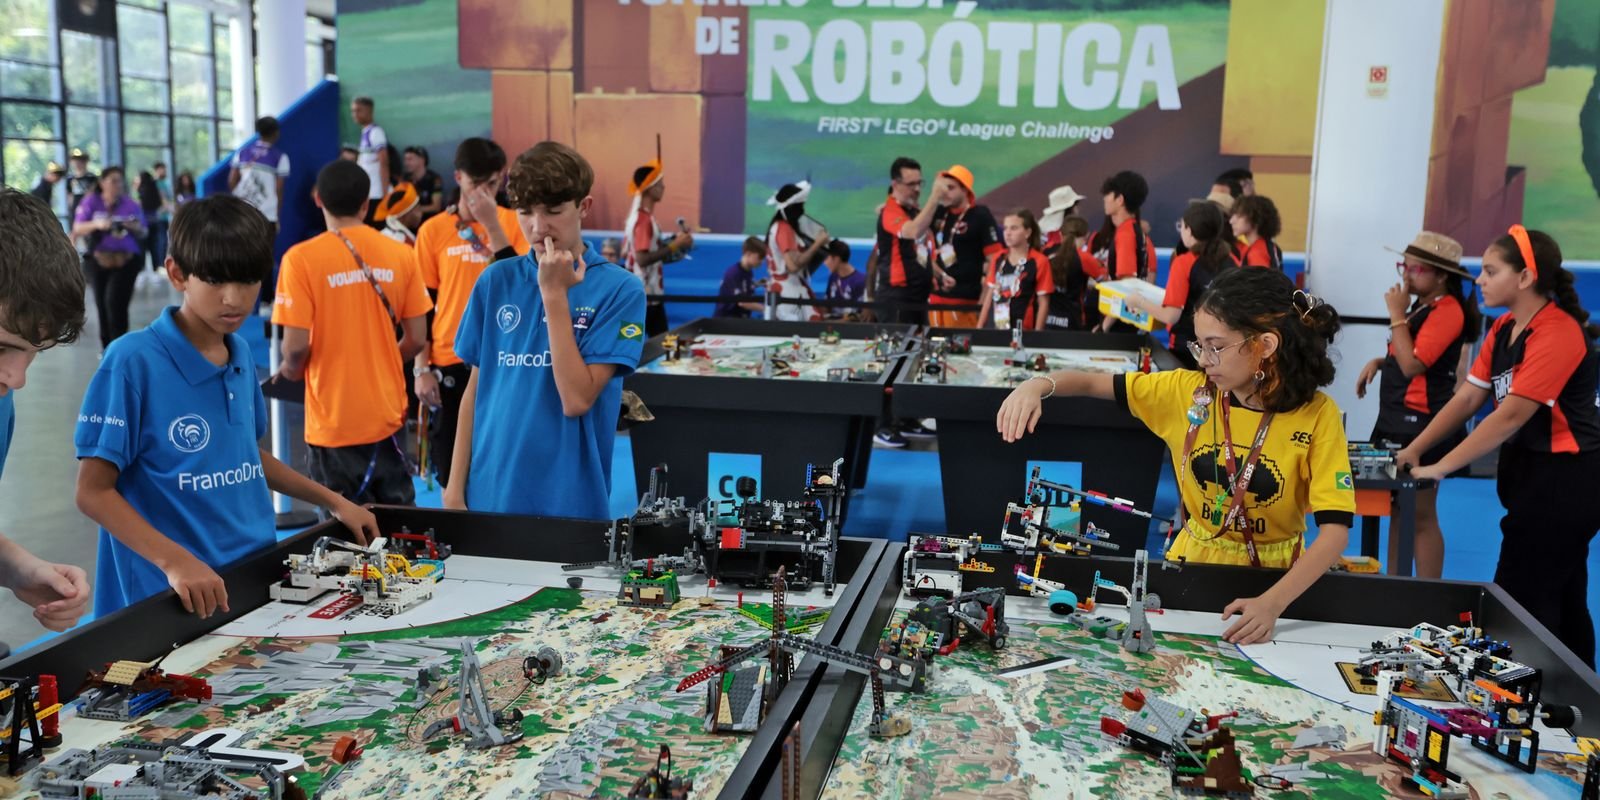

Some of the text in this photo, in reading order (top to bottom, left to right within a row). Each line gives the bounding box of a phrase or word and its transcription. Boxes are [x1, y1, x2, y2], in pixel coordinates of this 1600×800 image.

[695, 1, 1182, 111] DE ROBÓTICA
[948, 119, 1016, 141] League
[1021, 121, 1114, 143] Challenge
[90, 413, 103, 424] de
